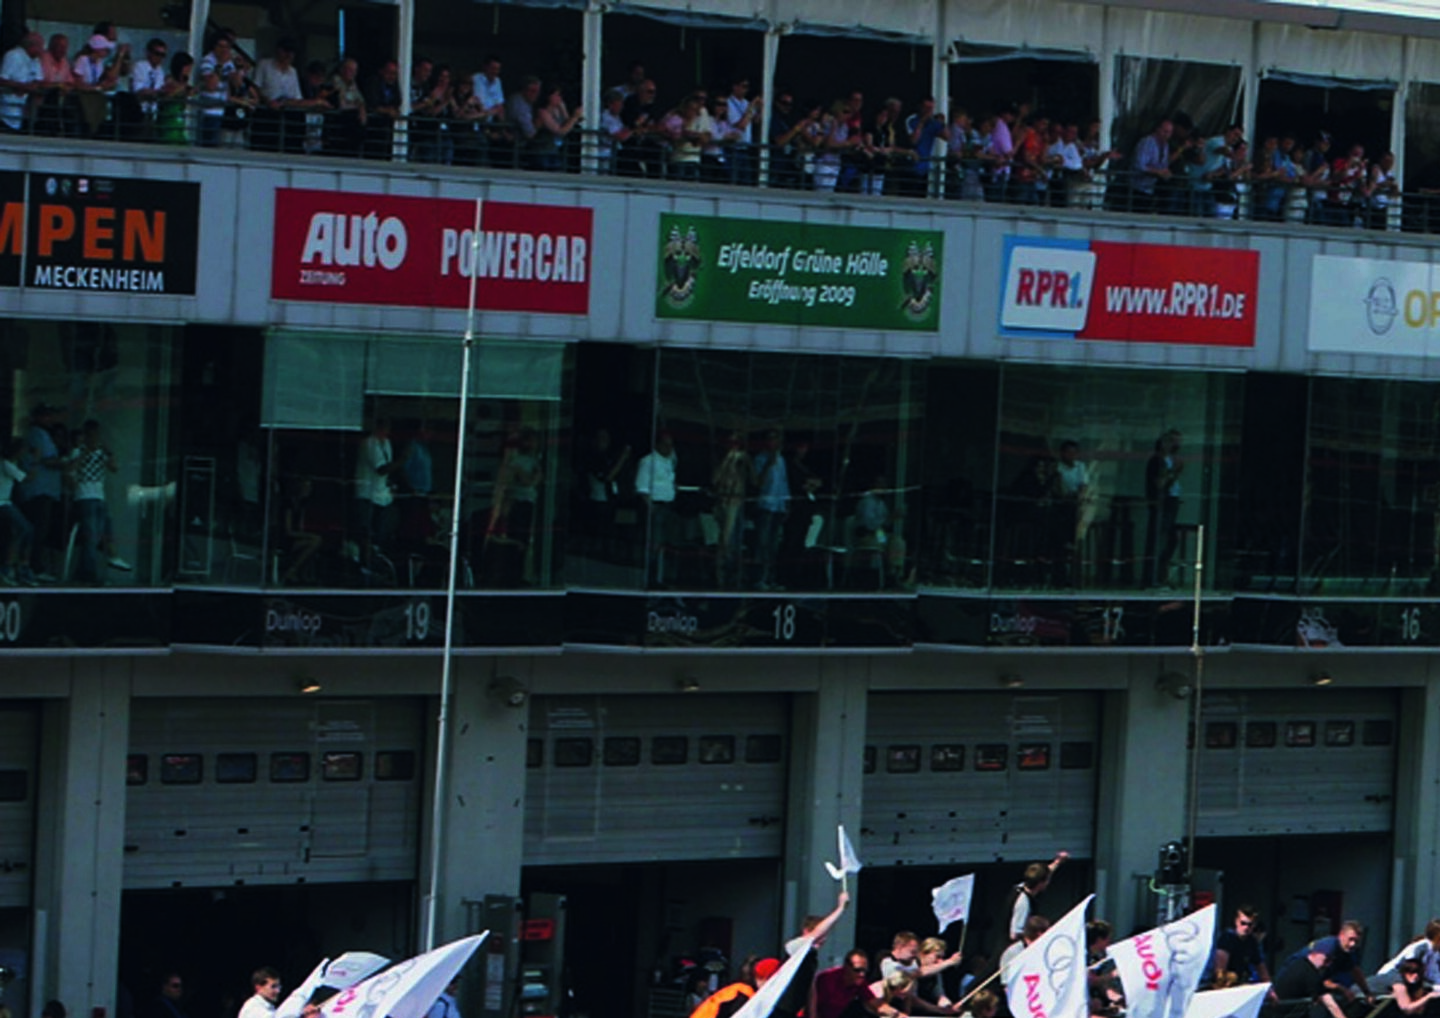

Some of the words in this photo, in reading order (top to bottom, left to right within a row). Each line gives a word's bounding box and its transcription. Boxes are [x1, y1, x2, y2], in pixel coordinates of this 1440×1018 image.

[301, 211, 408, 270] Auto
[440, 228, 586, 283] POWERCAR
[717, 242, 791, 275] Eifeldorf
[792, 249, 842, 273] Grüne
[846, 251, 889, 277] Hölle
[34, 265, 165, 292] MECKENHEIM
[749, 280, 815, 306] Eröffnung
[819, 285, 857, 305] 2009
[266, 610, 322, 634] Dunlop
[405, 602, 429, 640] 19
[648, 611, 698, 634] Dunlop
[773, 604, 795, 640] 18
[1103, 607, 1123, 640] 17
[1400, 607, 1420, 640] 16
